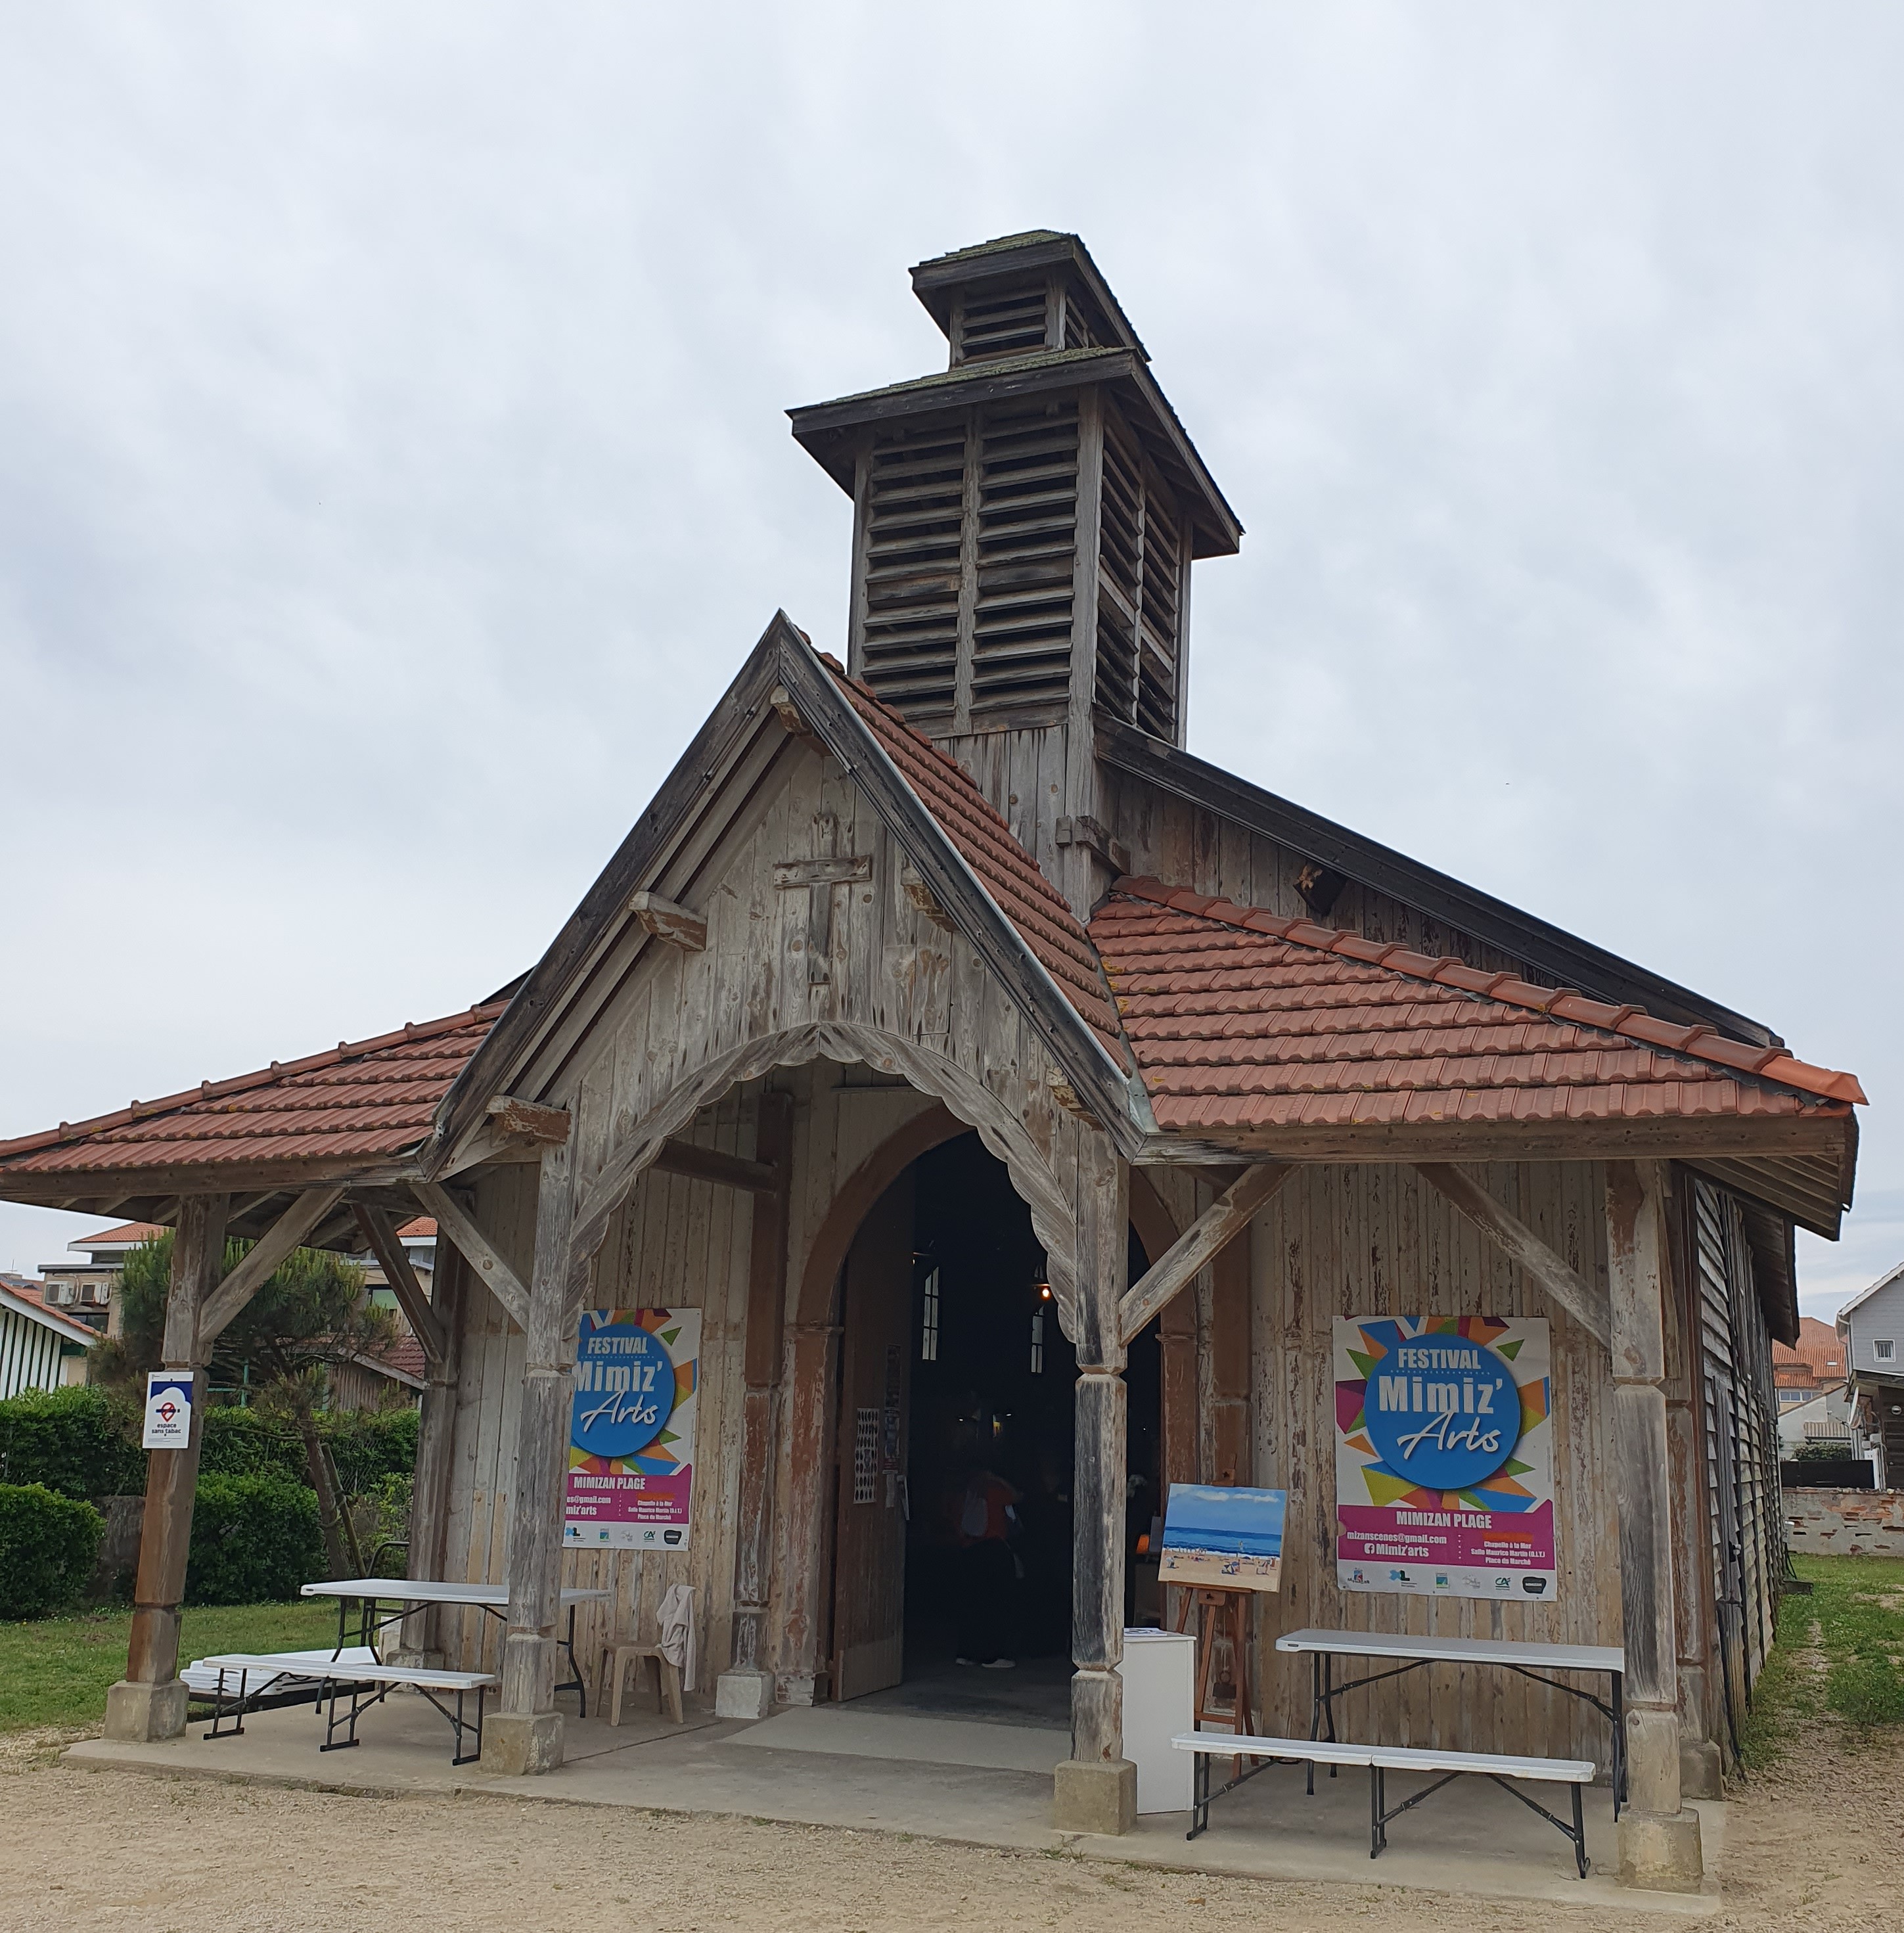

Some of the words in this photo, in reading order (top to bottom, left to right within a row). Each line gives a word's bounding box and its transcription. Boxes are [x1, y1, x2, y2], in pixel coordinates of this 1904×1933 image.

[587, 1337, 648, 1354] FESTIVAL
[1398, 1348, 1481, 1369] FESTIVAL
[576, 1361, 662, 1392] Mimiz'
[1379, 1376, 1503, 1413] Mimiz'
[580, 1390, 658, 1432] Arts
[1397, 1411, 1501, 1460] Arts
[574, 1476, 615, 1490] MIMIZAN
[617, 1478, 646, 1490] PLAGE
[566, 1505, 597, 1516] miz'arts
[1396, 1511, 1451, 1528] MIMIZAN
[1453, 1513, 1492, 1529] PLAGE
[1347, 1531, 1447, 1544] mizanscenes@gmail.com
[1376, 1543, 1430, 1558] Mimiz'arts
